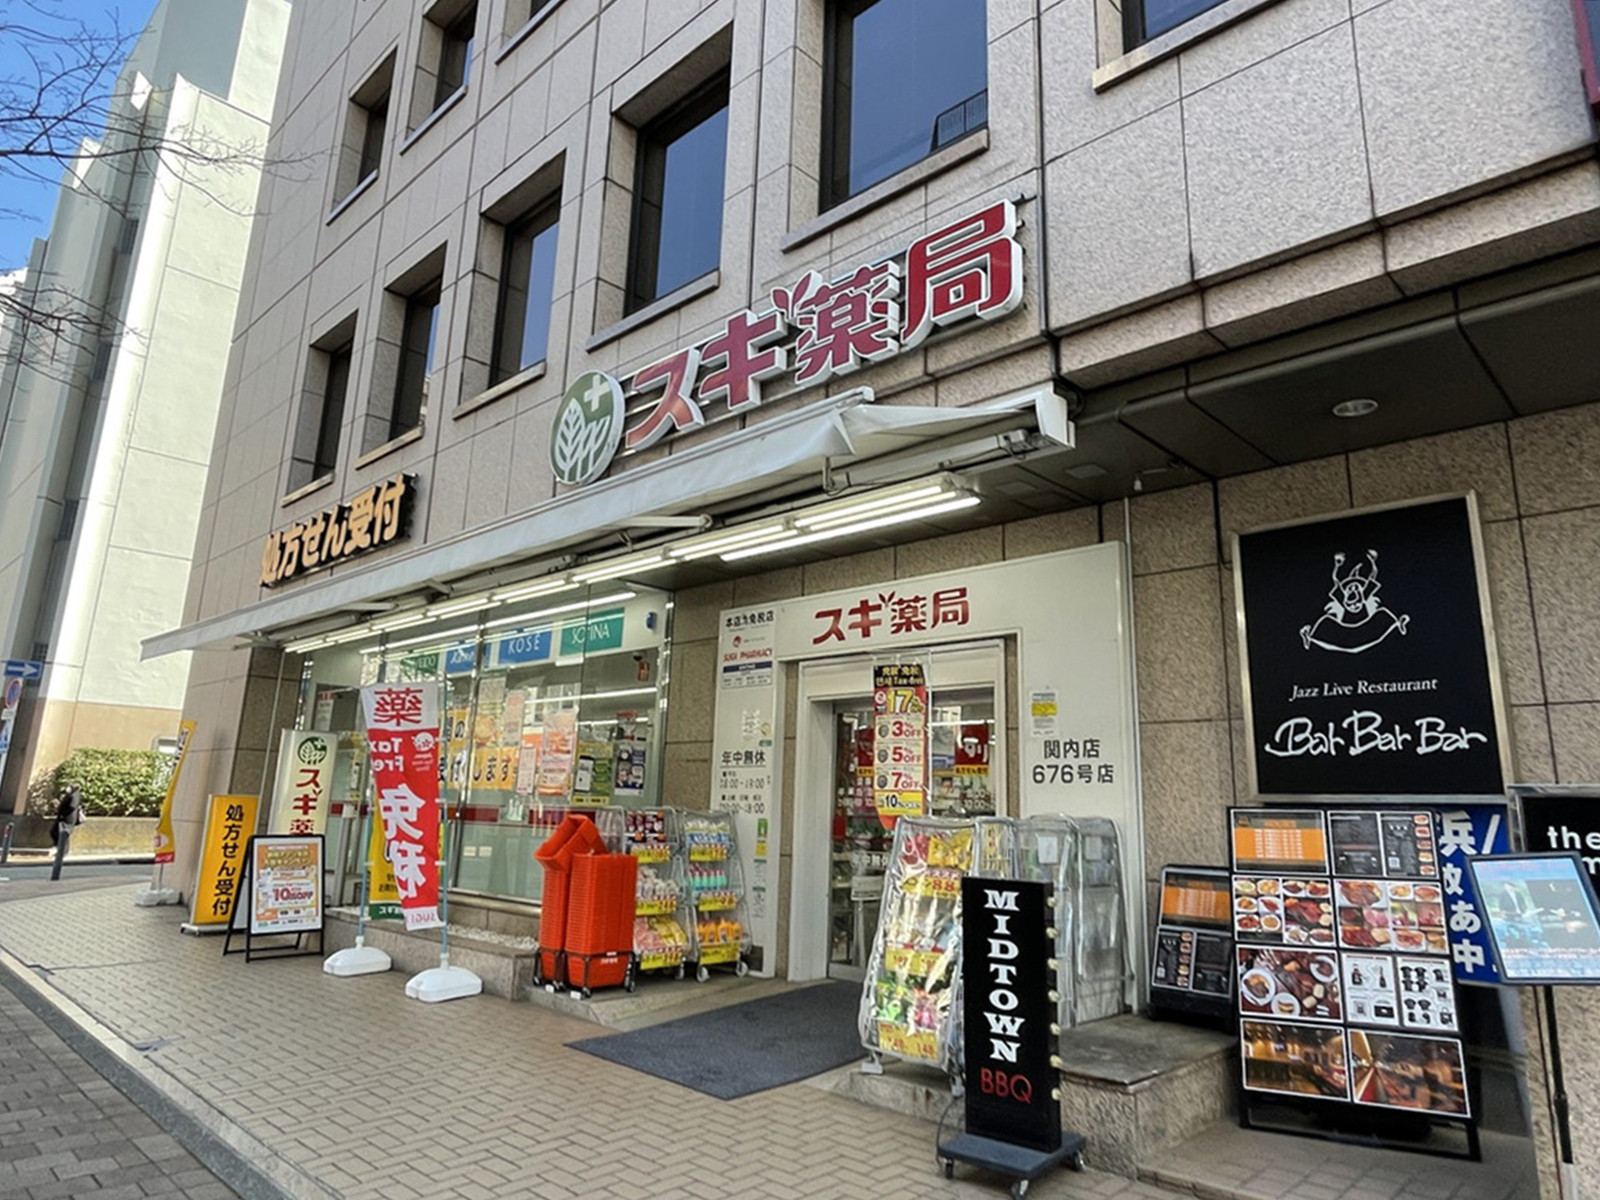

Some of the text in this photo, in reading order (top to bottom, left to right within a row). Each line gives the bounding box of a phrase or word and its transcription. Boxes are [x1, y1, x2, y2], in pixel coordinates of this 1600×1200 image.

[624, 199, 1022, 451] スギ薬局
[812, 587, 970, 645] スギ薬局
[1289, 677, 1438, 702] Jazz Live Restaurant
[1043, 738, 1101, 759] 関内店
[1264, 710, 1488, 758] Bar Bar Bar
[721, 750, 766, 765] 年中無休
[1032, 764, 1114, 784] 676号店
[212, 803, 245, 916] 処方せん受付
[983, 889, 1026, 1064] MIDTOWN
[980, 1066, 1033, 1105] BBQ
